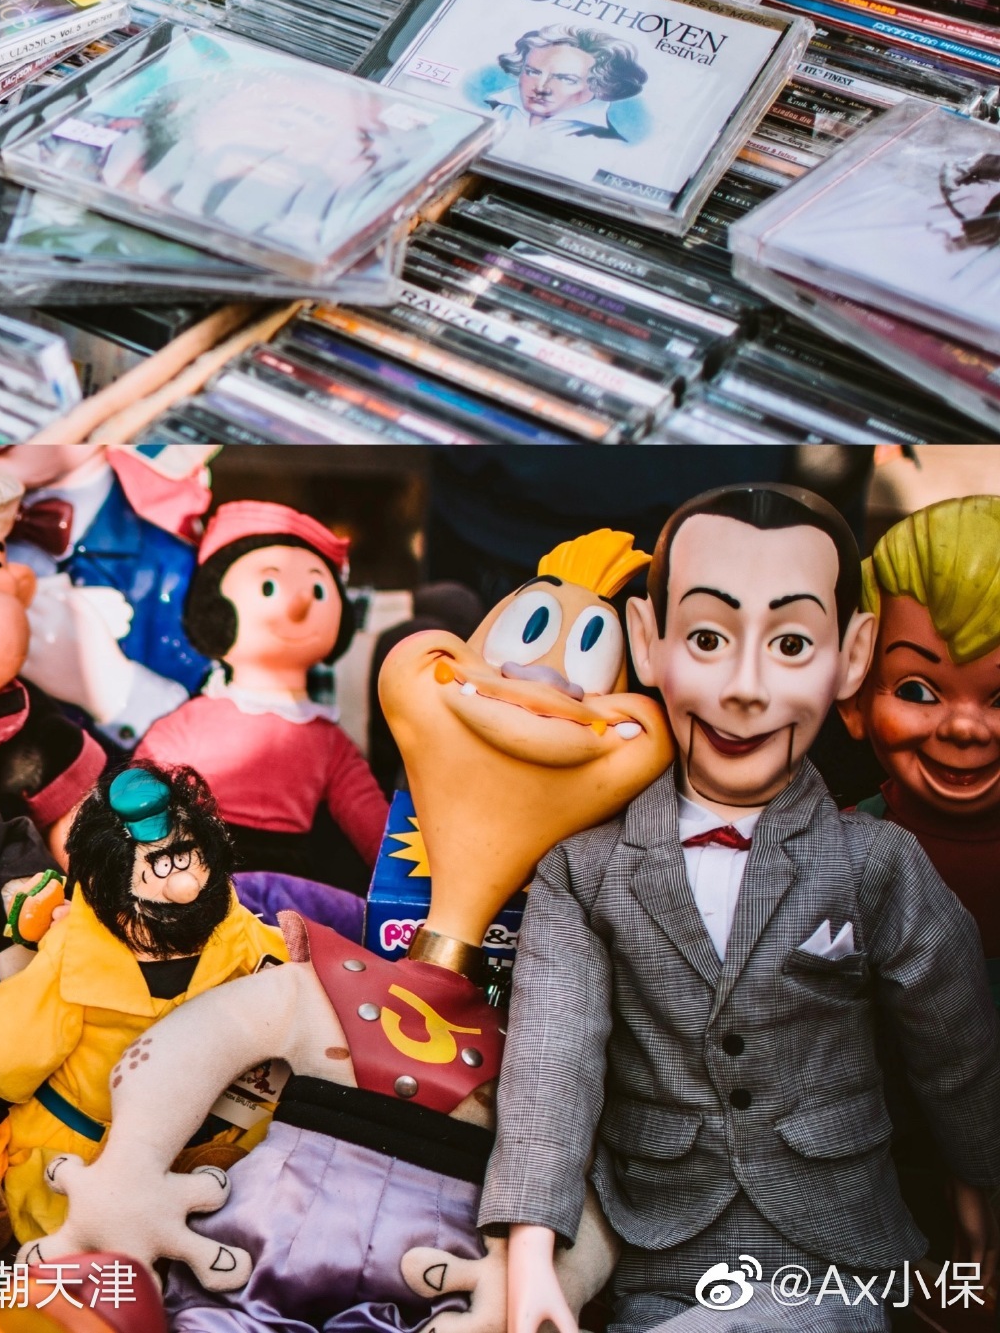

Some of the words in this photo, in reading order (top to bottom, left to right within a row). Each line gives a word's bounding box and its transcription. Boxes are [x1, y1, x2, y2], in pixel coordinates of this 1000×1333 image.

[869, 2, 897, 16] PARIS
[8, 32, 57, 59] CLASSICS
[654, 37, 717, 66] festival
[823, 70, 855, 87] FINEST
